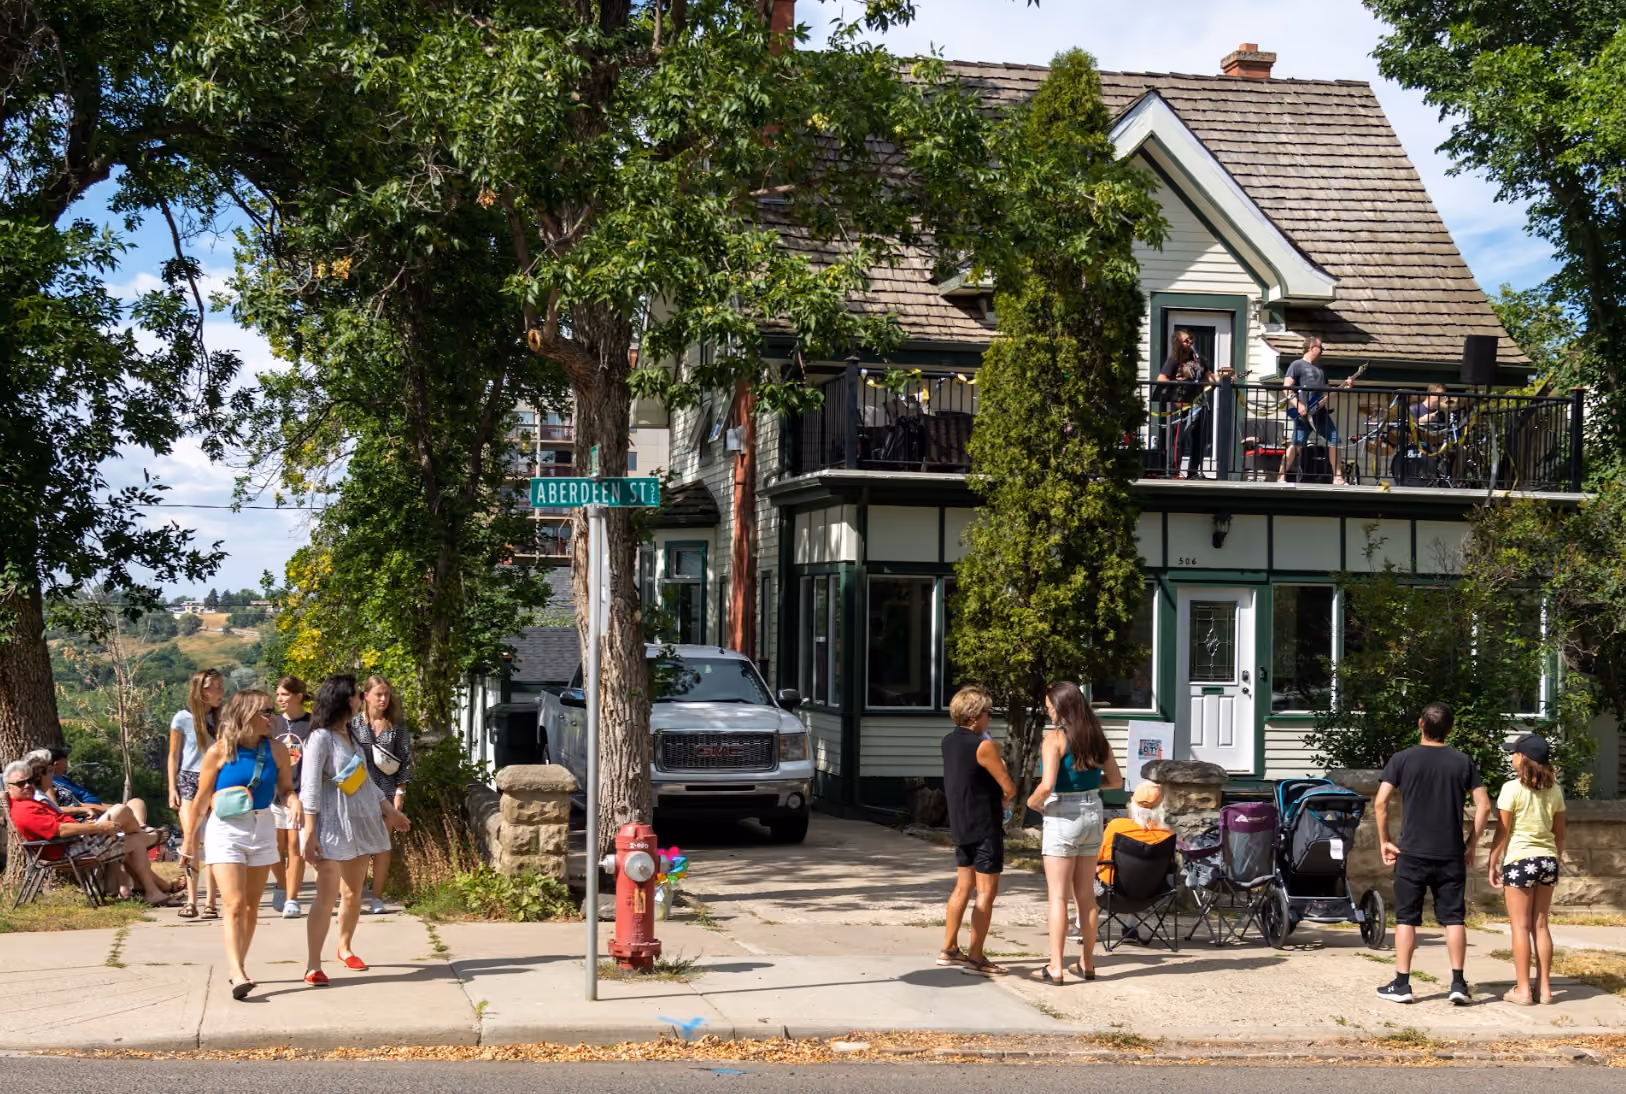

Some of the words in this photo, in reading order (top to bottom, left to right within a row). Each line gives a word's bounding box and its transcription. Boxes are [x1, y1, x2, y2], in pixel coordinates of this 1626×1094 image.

[537, 482, 621, 504] ABERDEEN
[629, 482, 647, 504] ST
[1178, 557, 1197, 566] 506
[696, 744, 744, 757] GMC
